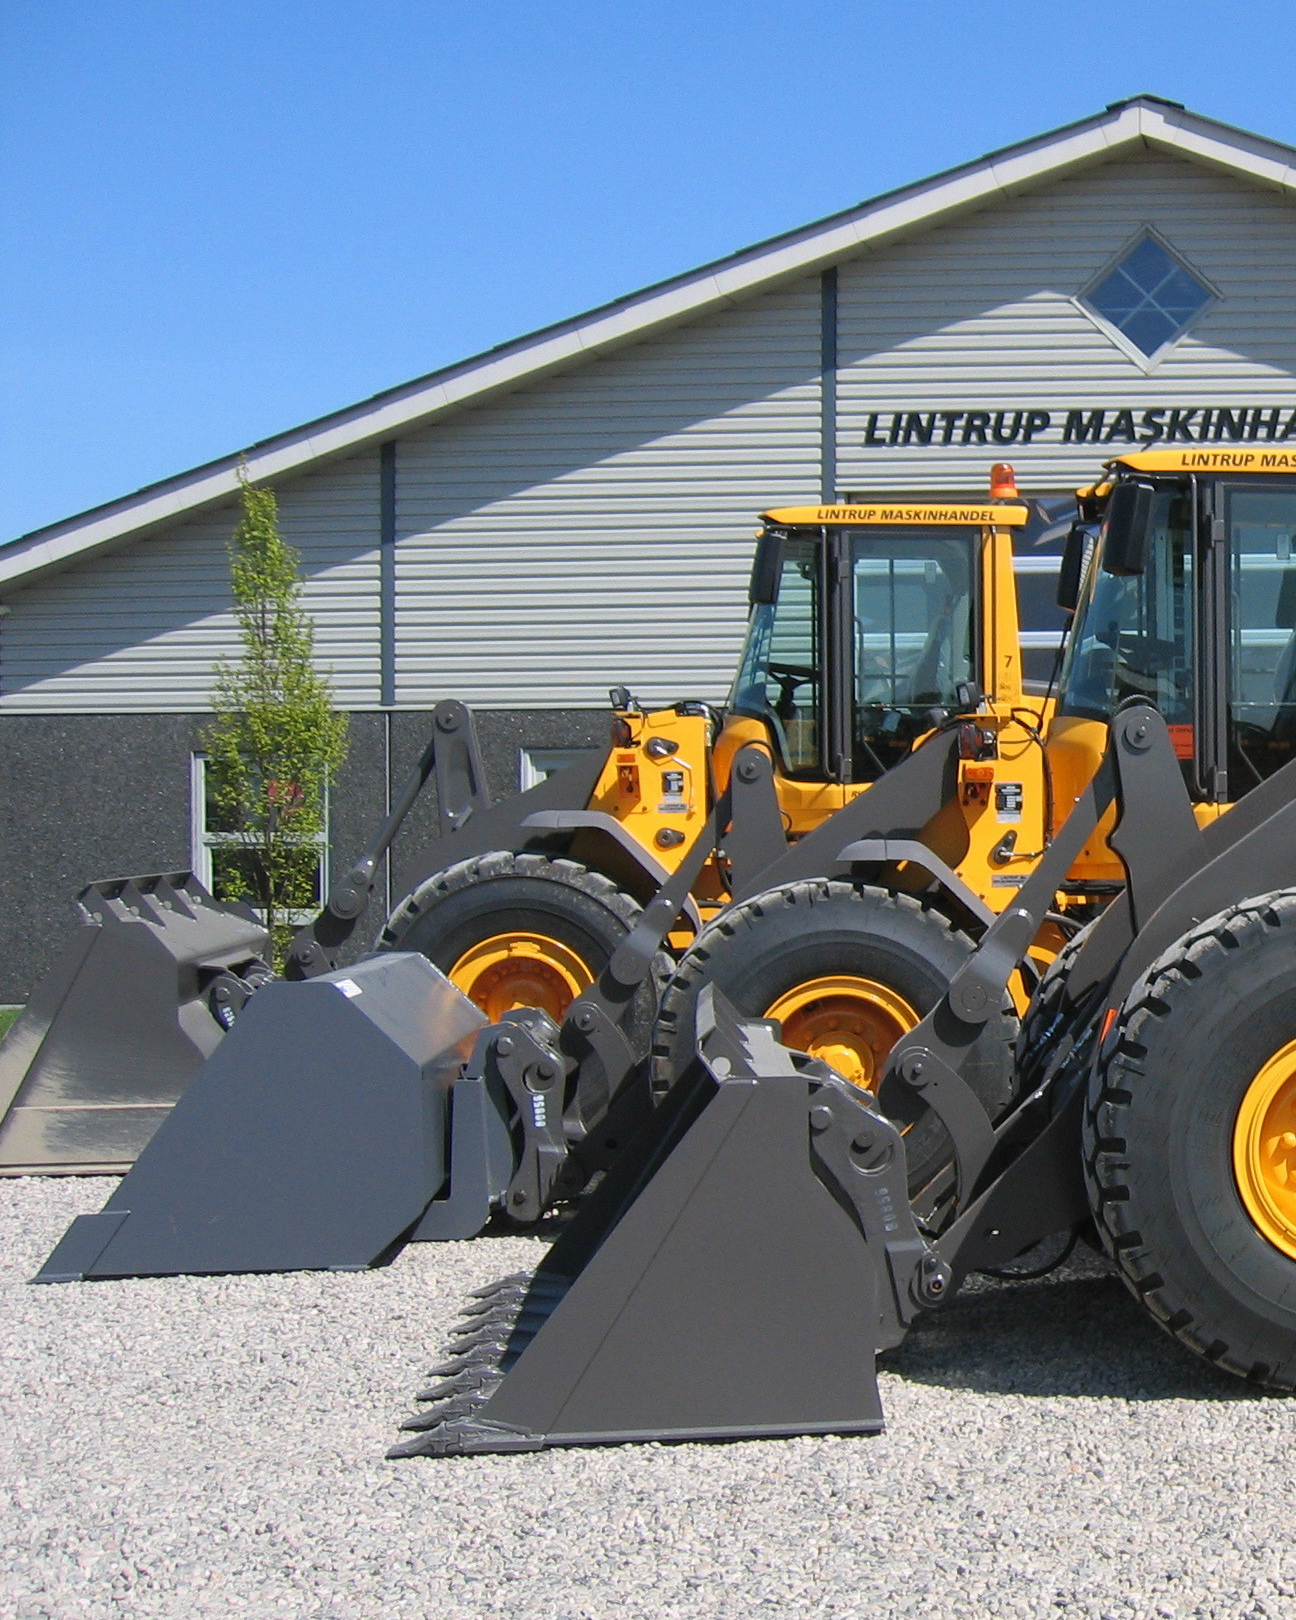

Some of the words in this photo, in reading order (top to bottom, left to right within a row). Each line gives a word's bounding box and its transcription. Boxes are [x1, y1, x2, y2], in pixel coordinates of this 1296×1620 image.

[864, 410, 1051, 445] LINTRUP
[1181, 453, 1255, 467] LINTRUP
[817, 509, 876, 520] LINTRUP
[880, 510, 995, 522] MASKINHANDEL
[1003, 655, 1013, 668] 7
